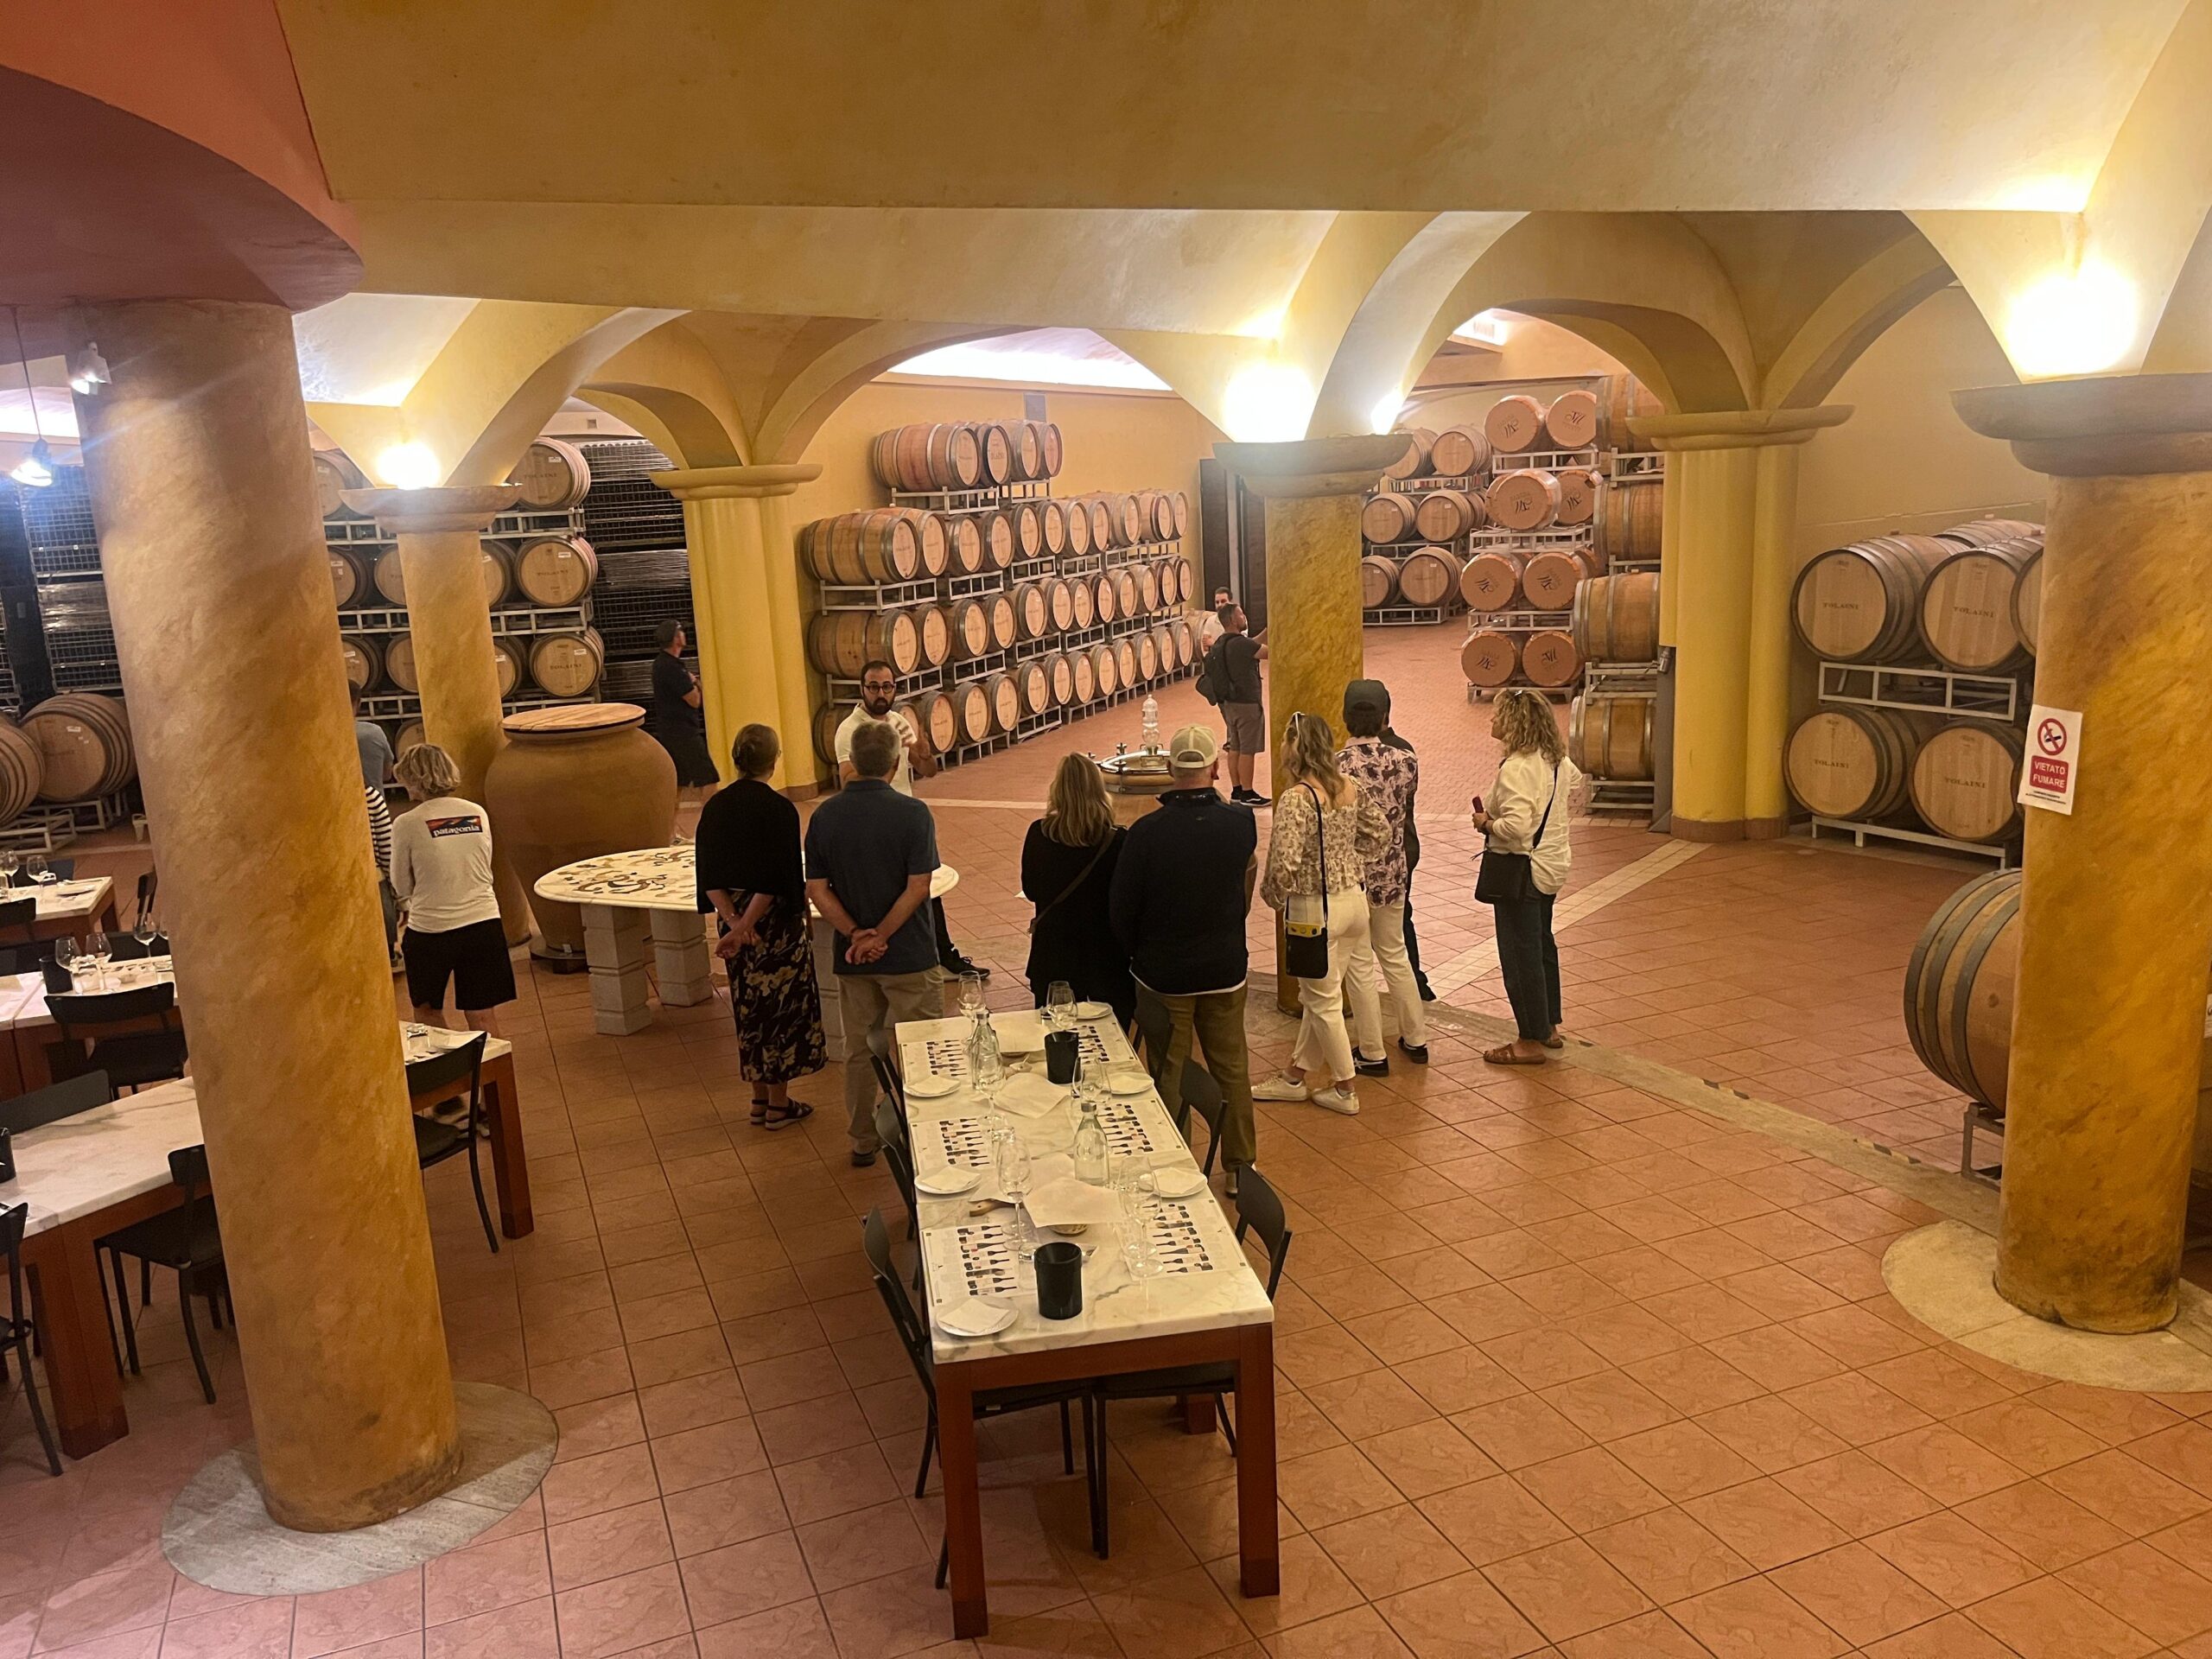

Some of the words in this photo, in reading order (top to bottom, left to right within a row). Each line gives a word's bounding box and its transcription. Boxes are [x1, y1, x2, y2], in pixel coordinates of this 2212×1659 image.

[1953, 606, 1994, 618] TOLAINI
[1814, 759, 1849, 769] TOLAINI
[2033, 760, 2066, 775] VIETATO
[1944, 777, 1986, 789] TOLAINI
[2032, 773, 2065, 788] FUMARE
[433, 824, 480, 837] patagonia
